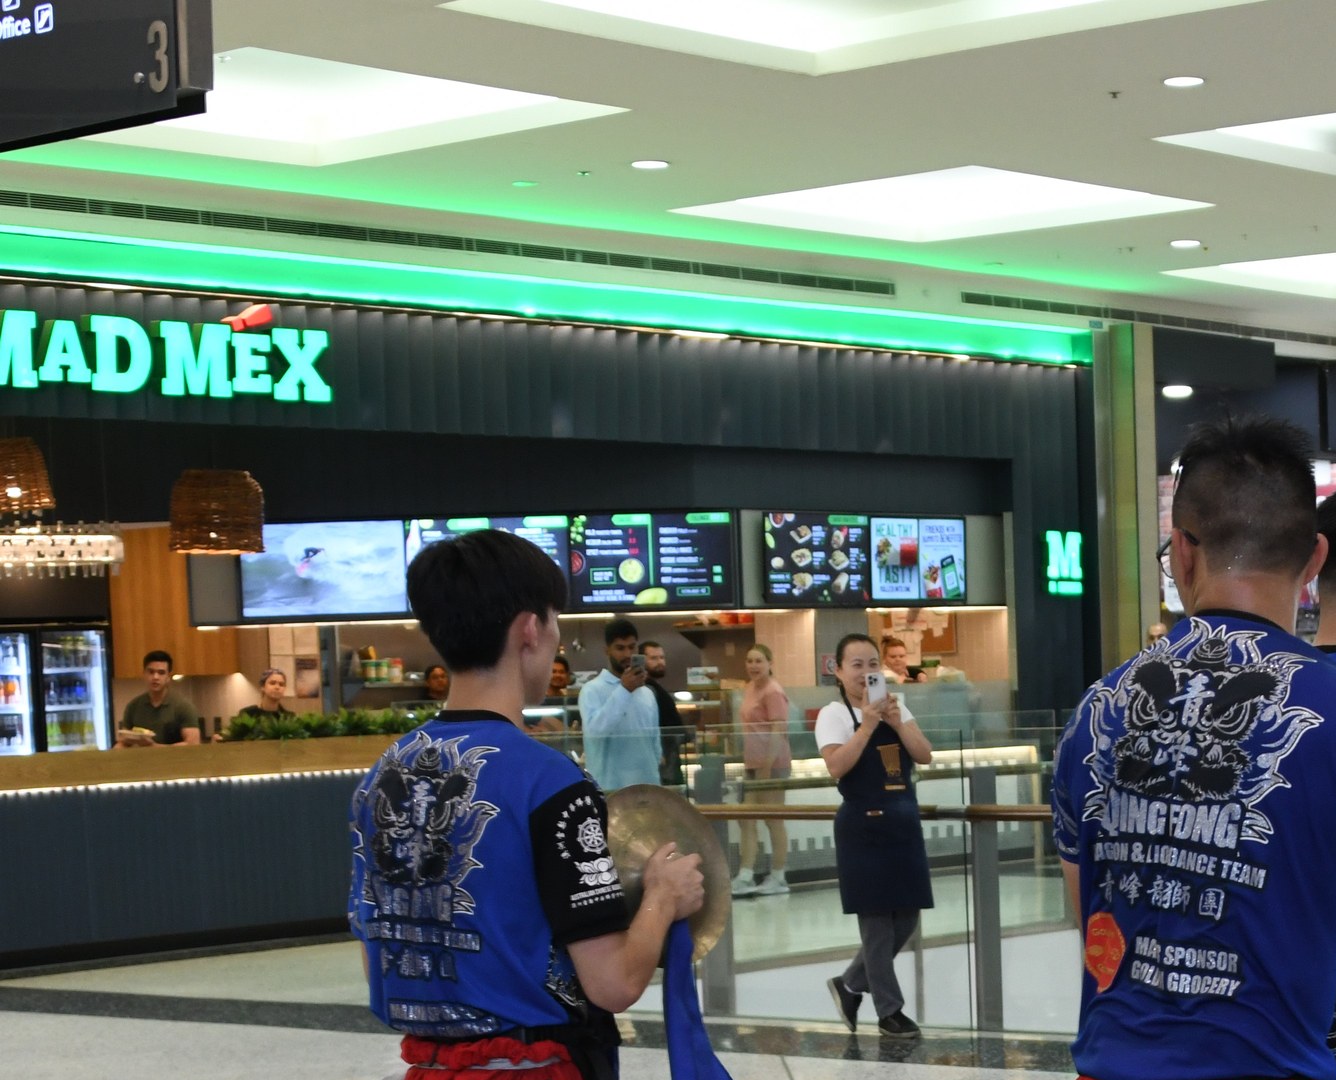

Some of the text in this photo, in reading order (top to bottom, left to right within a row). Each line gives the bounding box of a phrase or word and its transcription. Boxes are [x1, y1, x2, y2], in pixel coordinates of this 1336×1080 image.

[147, 20, 169, 93] 3
[159, 320, 332, 402] MEX
[1131, 842, 1145, 863] &
[1221, 859, 1267, 889] TEAM
[1163, 944, 1239, 974] SPONSOR
[1167, 971, 1241, 997] GROCERY
